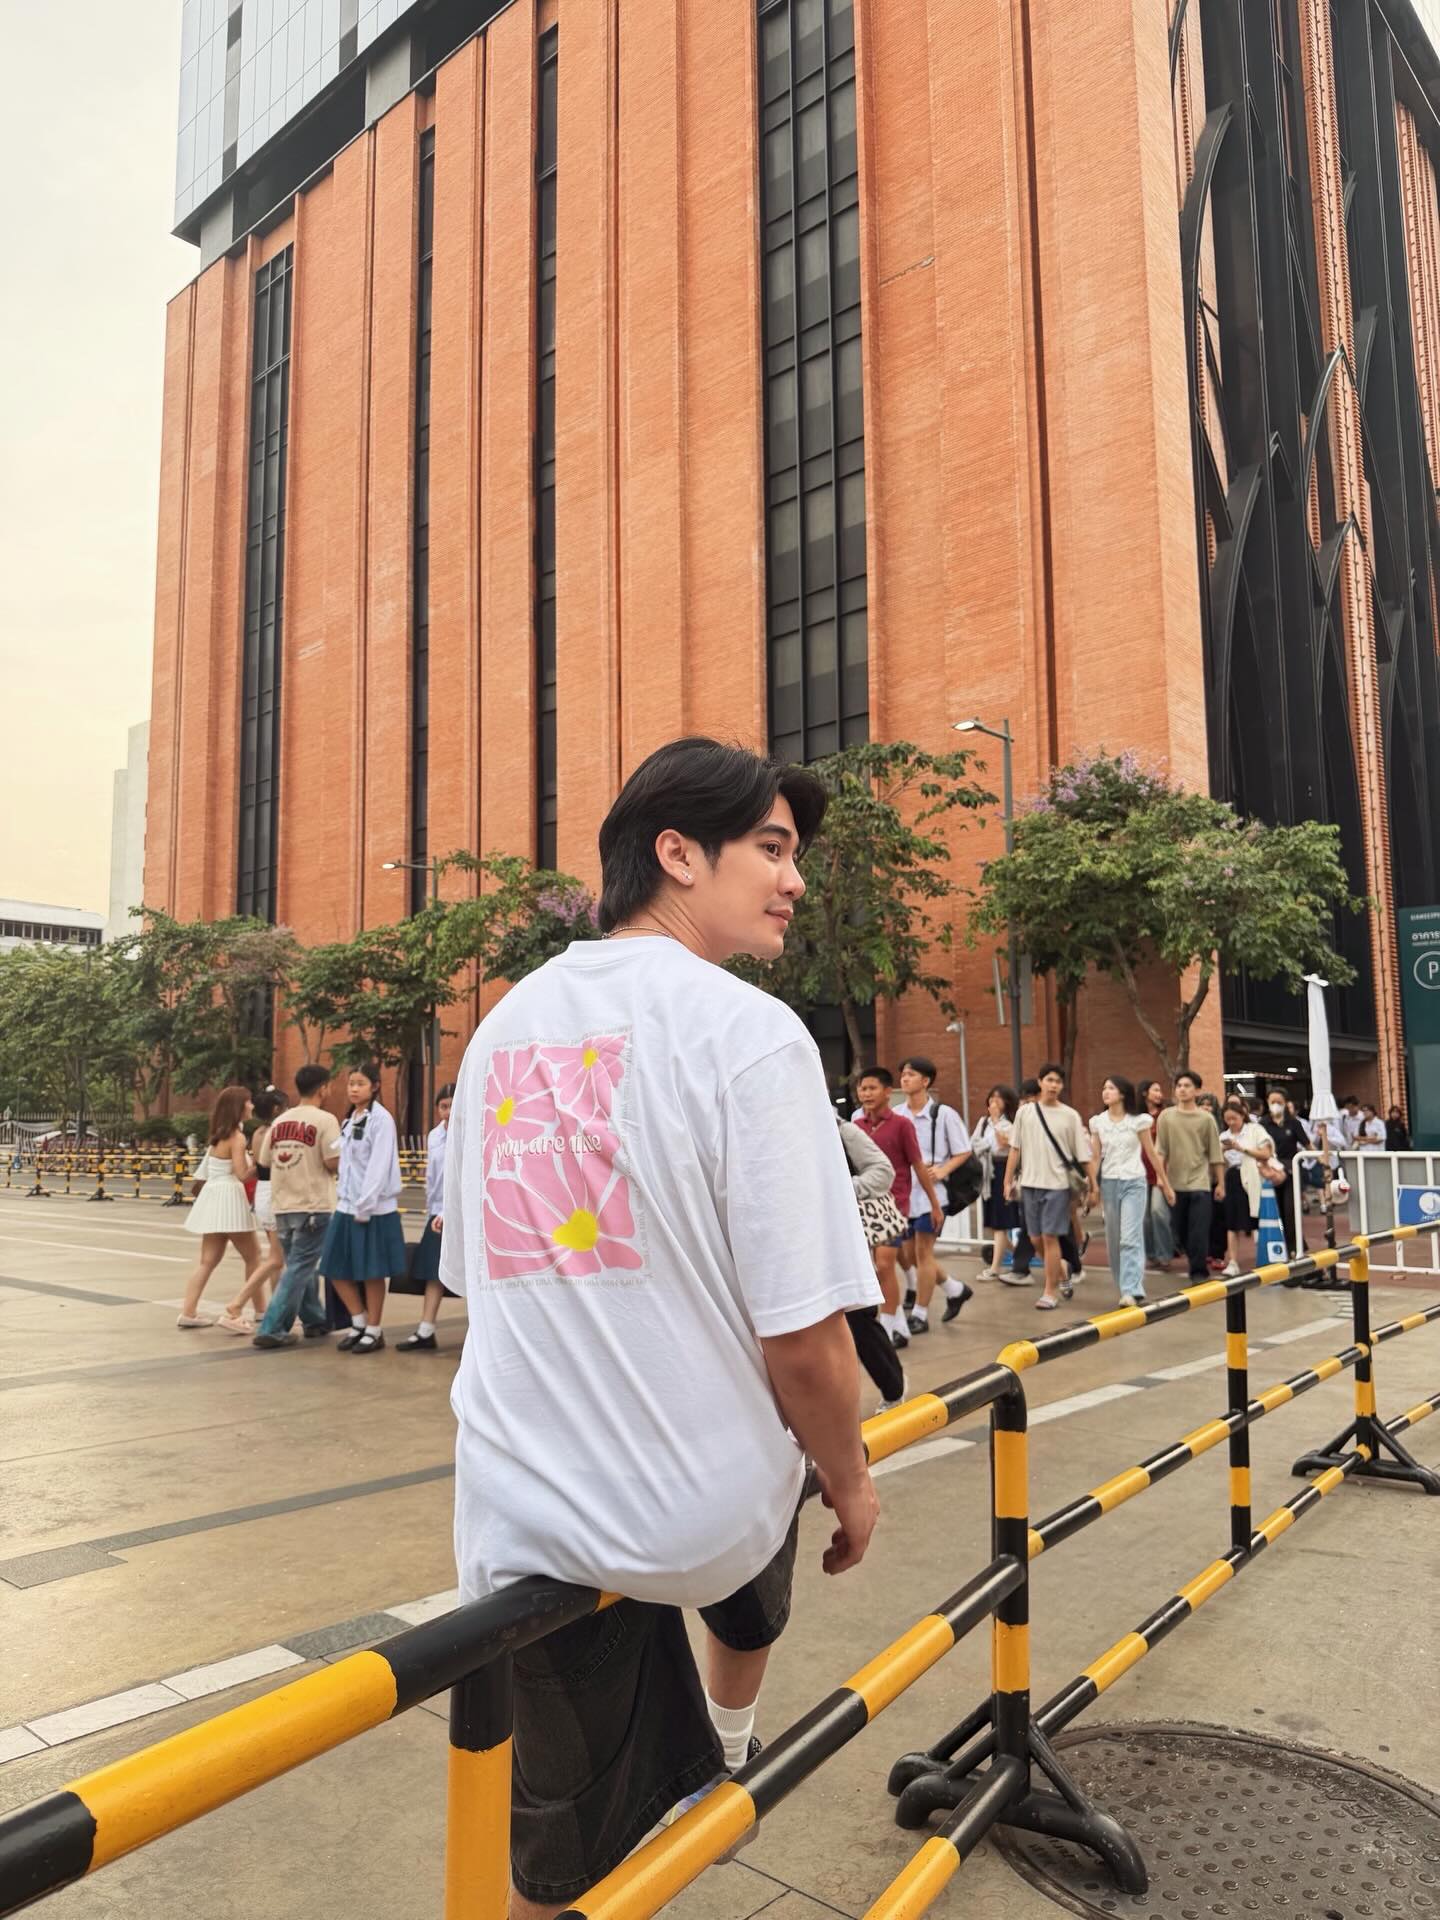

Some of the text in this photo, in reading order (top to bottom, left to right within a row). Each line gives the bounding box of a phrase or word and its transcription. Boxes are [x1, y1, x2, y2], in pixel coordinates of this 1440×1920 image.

[1428, 961, 1439, 980] P
[496, 1138, 524, 1168] you
[527, 1135, 565, 1155] are
